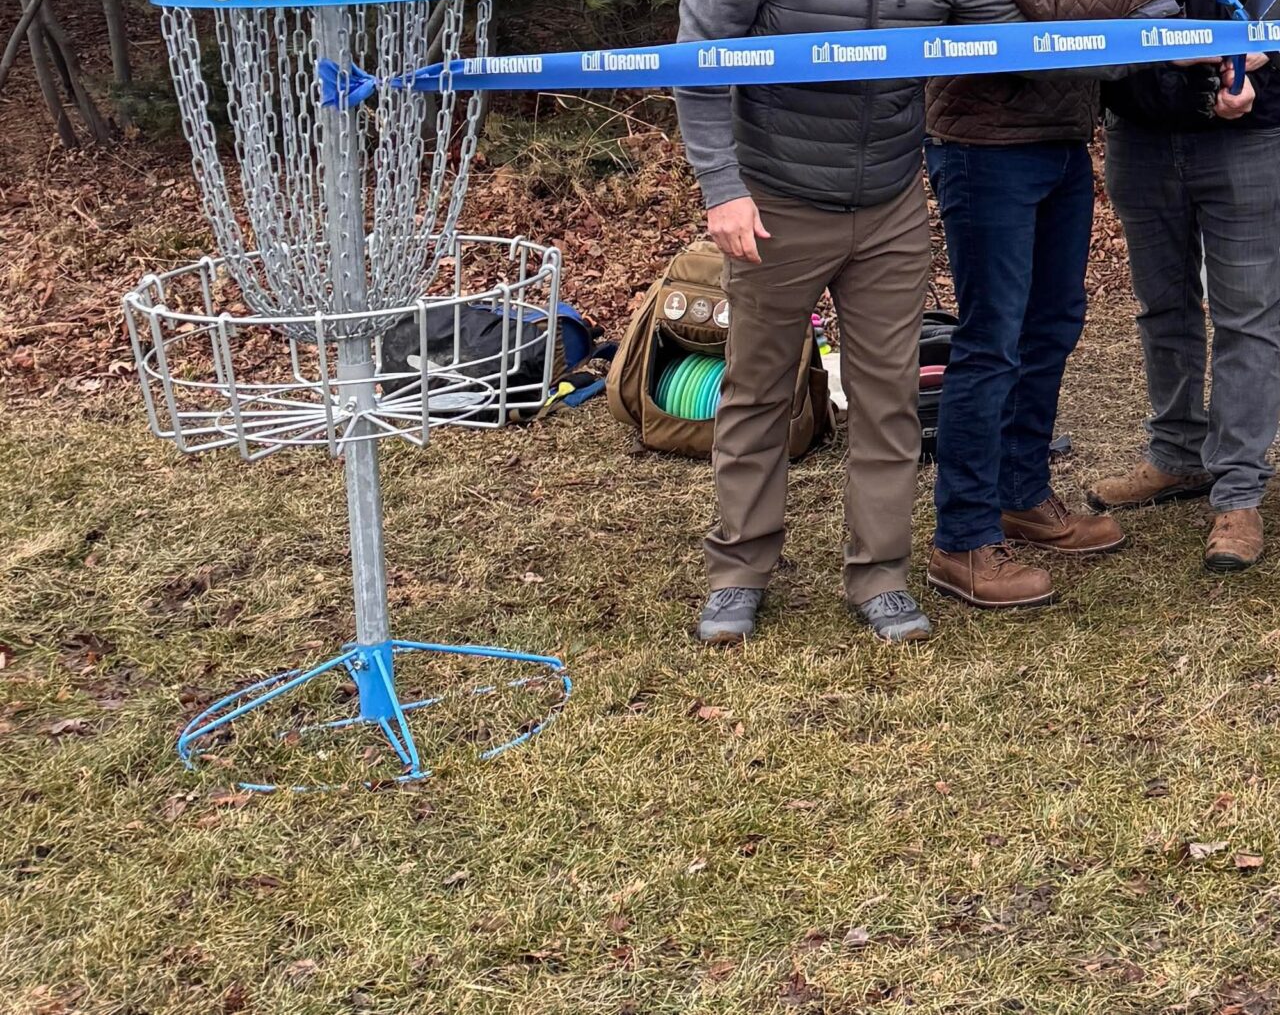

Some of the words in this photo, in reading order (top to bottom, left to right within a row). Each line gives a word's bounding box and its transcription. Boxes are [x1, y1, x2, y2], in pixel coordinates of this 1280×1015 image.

[1052, 34, 1106, 52] TORONTO
[1160, 28, 1213, 46] TORONTO
[831, 43, 887, 63] TORONTO
[943, 39, 998, 57] TORONTO
[485, 57, 542, 74] TORONTO
[603, 52, 659, 71] TORONTO
[717, 48, 774, 67] TORONTO
